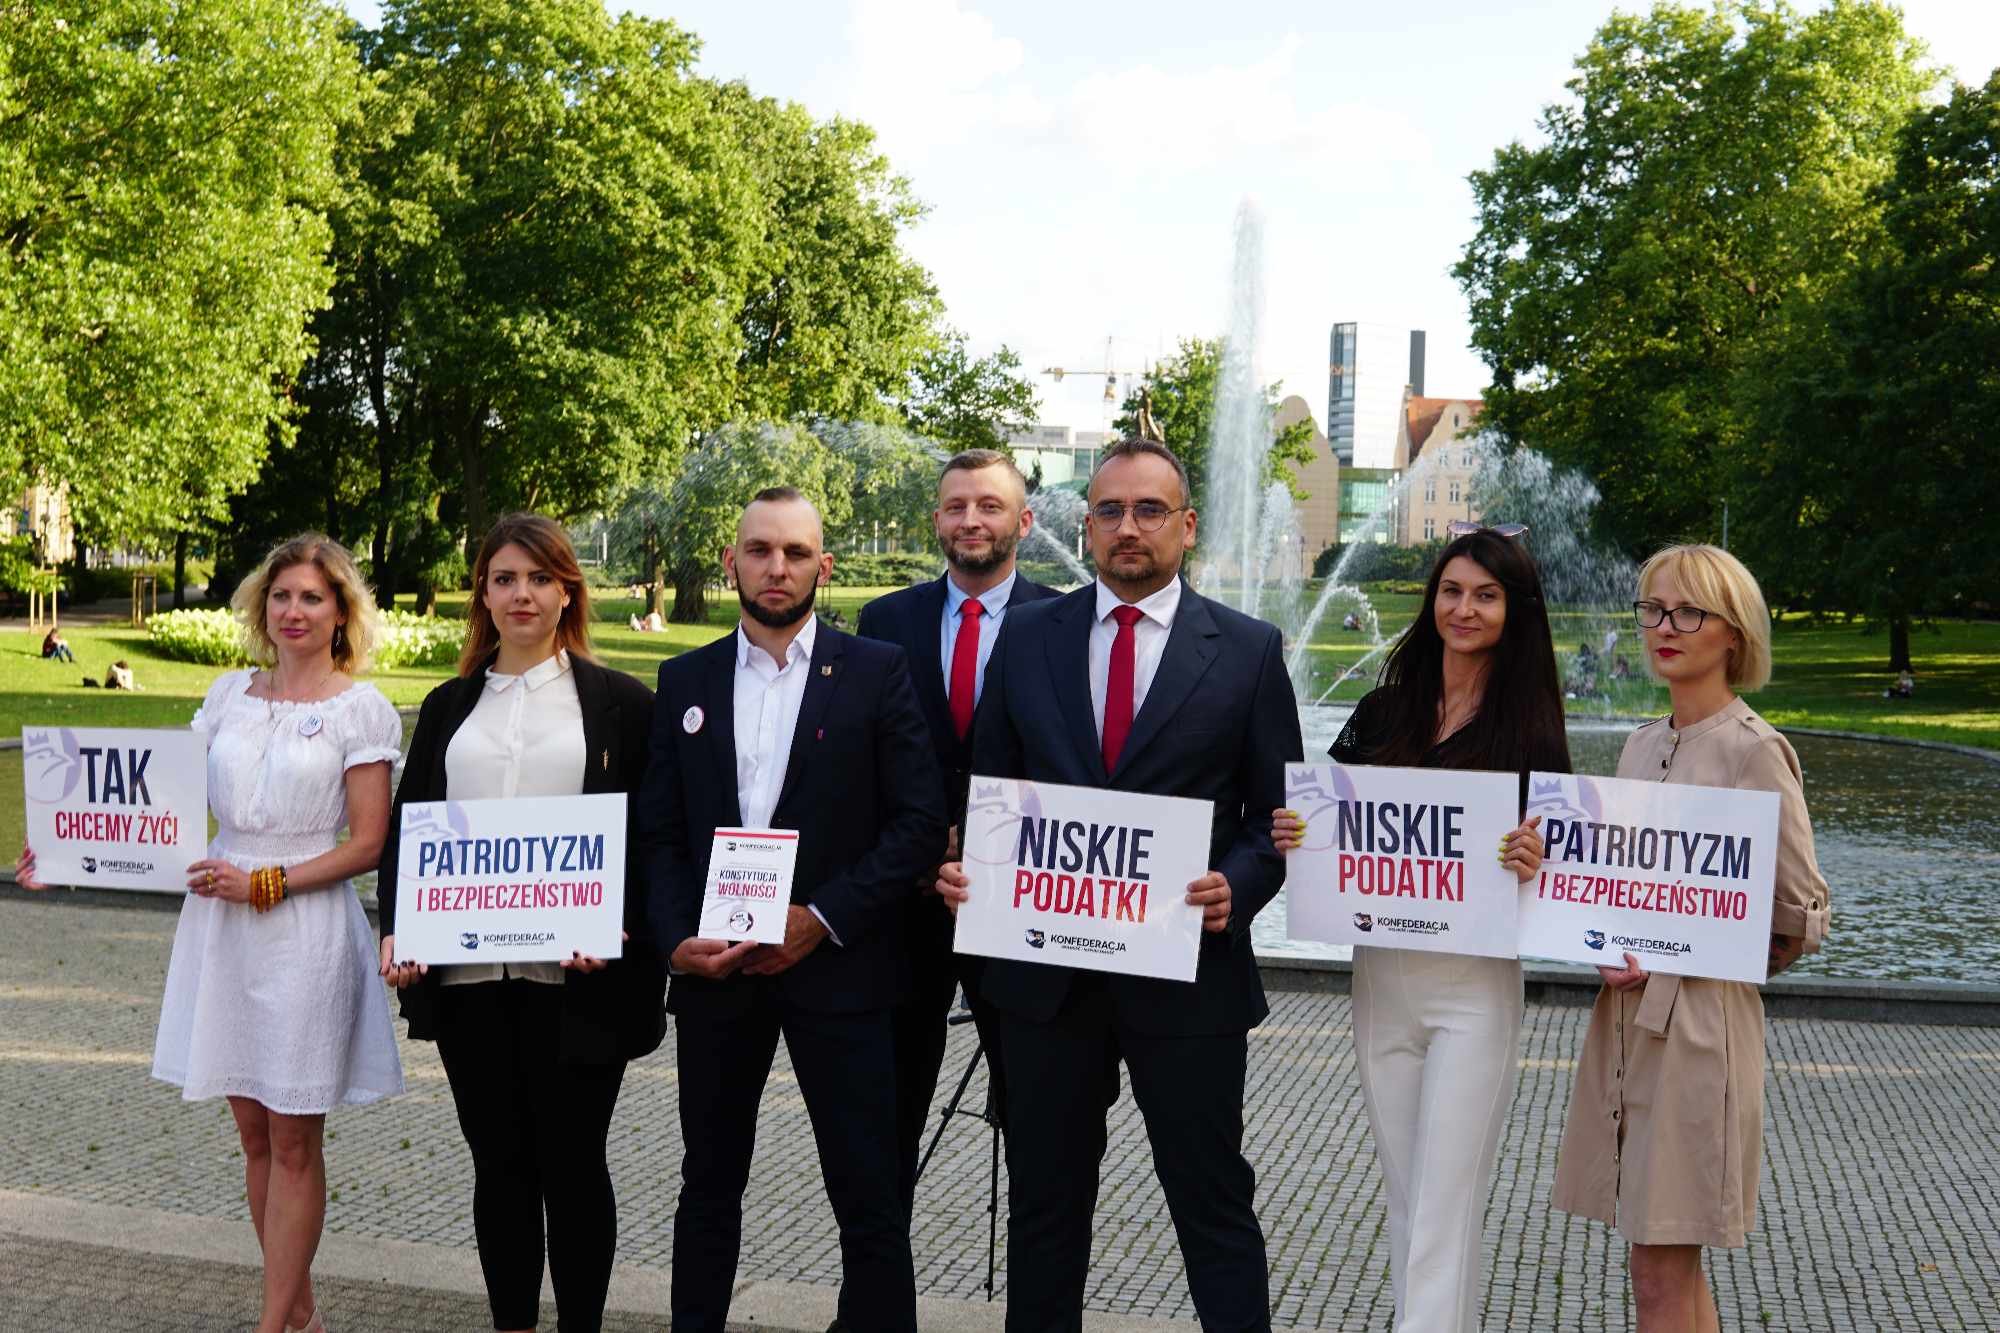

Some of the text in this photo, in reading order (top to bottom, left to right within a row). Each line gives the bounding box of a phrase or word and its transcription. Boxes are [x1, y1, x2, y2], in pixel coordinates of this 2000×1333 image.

[80, 748, 152, 806] TAK
[55, 810, 178, 846] CHCEMY ŻYĆ!
[1338, 800, 1464, 858] NISKIE
[418, 834, 604, 877] PATRIOTYZM
[1017, 816, 1154, 880] NISKIE
[1544, 818, 1752, 880] PATRIOTYZM
[416, 879, 603, 912] I BEZPIECZEŃSTWO
[718, 881, 777, 899] WOLNOŚCI
[719, 869, 777, 883] KONSTYTUCJA
[1338, 854, 1464, 902] PODATKI
[1013, 869, 1149, 924] PODATKI
[1538, 871, 1748, 921] I BEZPIECZEŃSTWO
[483, 932, 555, 943] KONFEDERACJA
[1050, 933, 1127, 952] KONFEDERACJA
[1377, 917, 1450, 931] KONFEDERACJA
[1611, 935, 1692, 953] KONFEDERACJA
